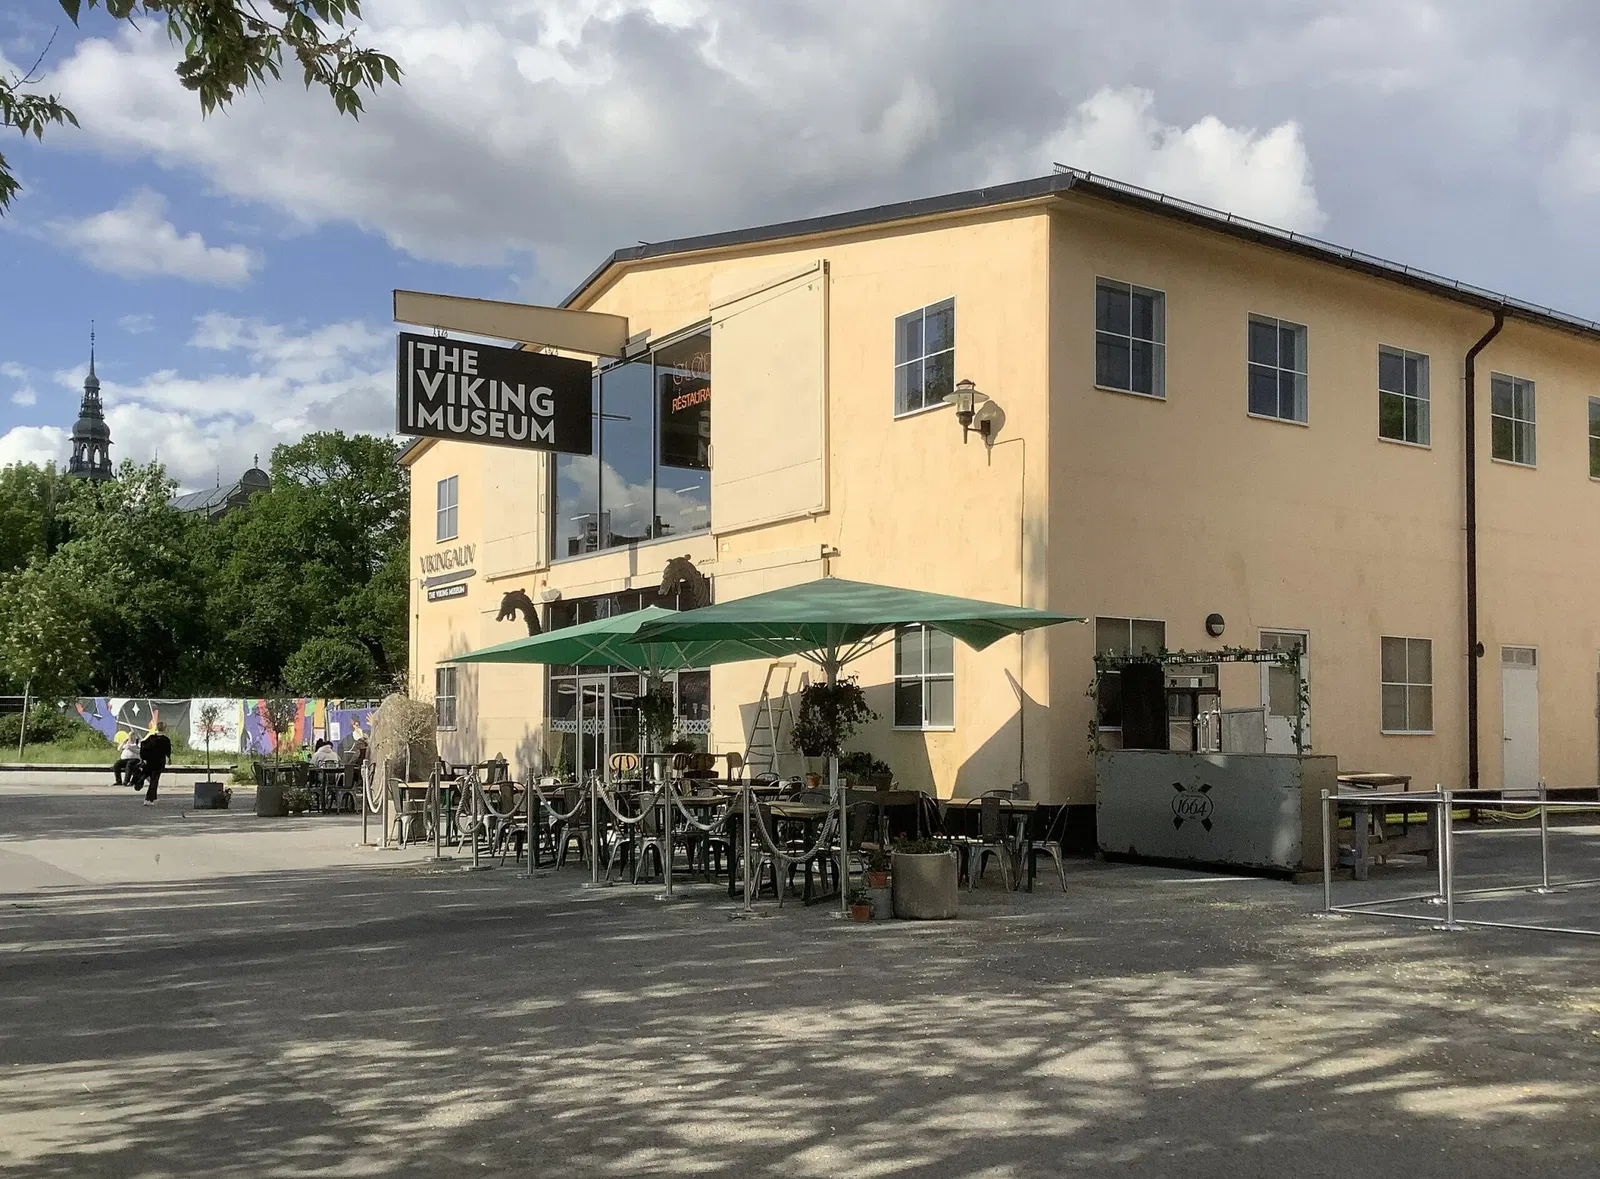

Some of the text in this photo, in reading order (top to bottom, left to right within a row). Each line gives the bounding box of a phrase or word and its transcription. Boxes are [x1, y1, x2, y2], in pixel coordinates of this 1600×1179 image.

[417, 342, 478, 375] THE
[416, 369, 554, 417] VIKING
[417, 402, 555, 444] MUSEUM
[420, 543, 476, 574] VIKINGALIV
[1177, 799, 1207, 816] 1664
